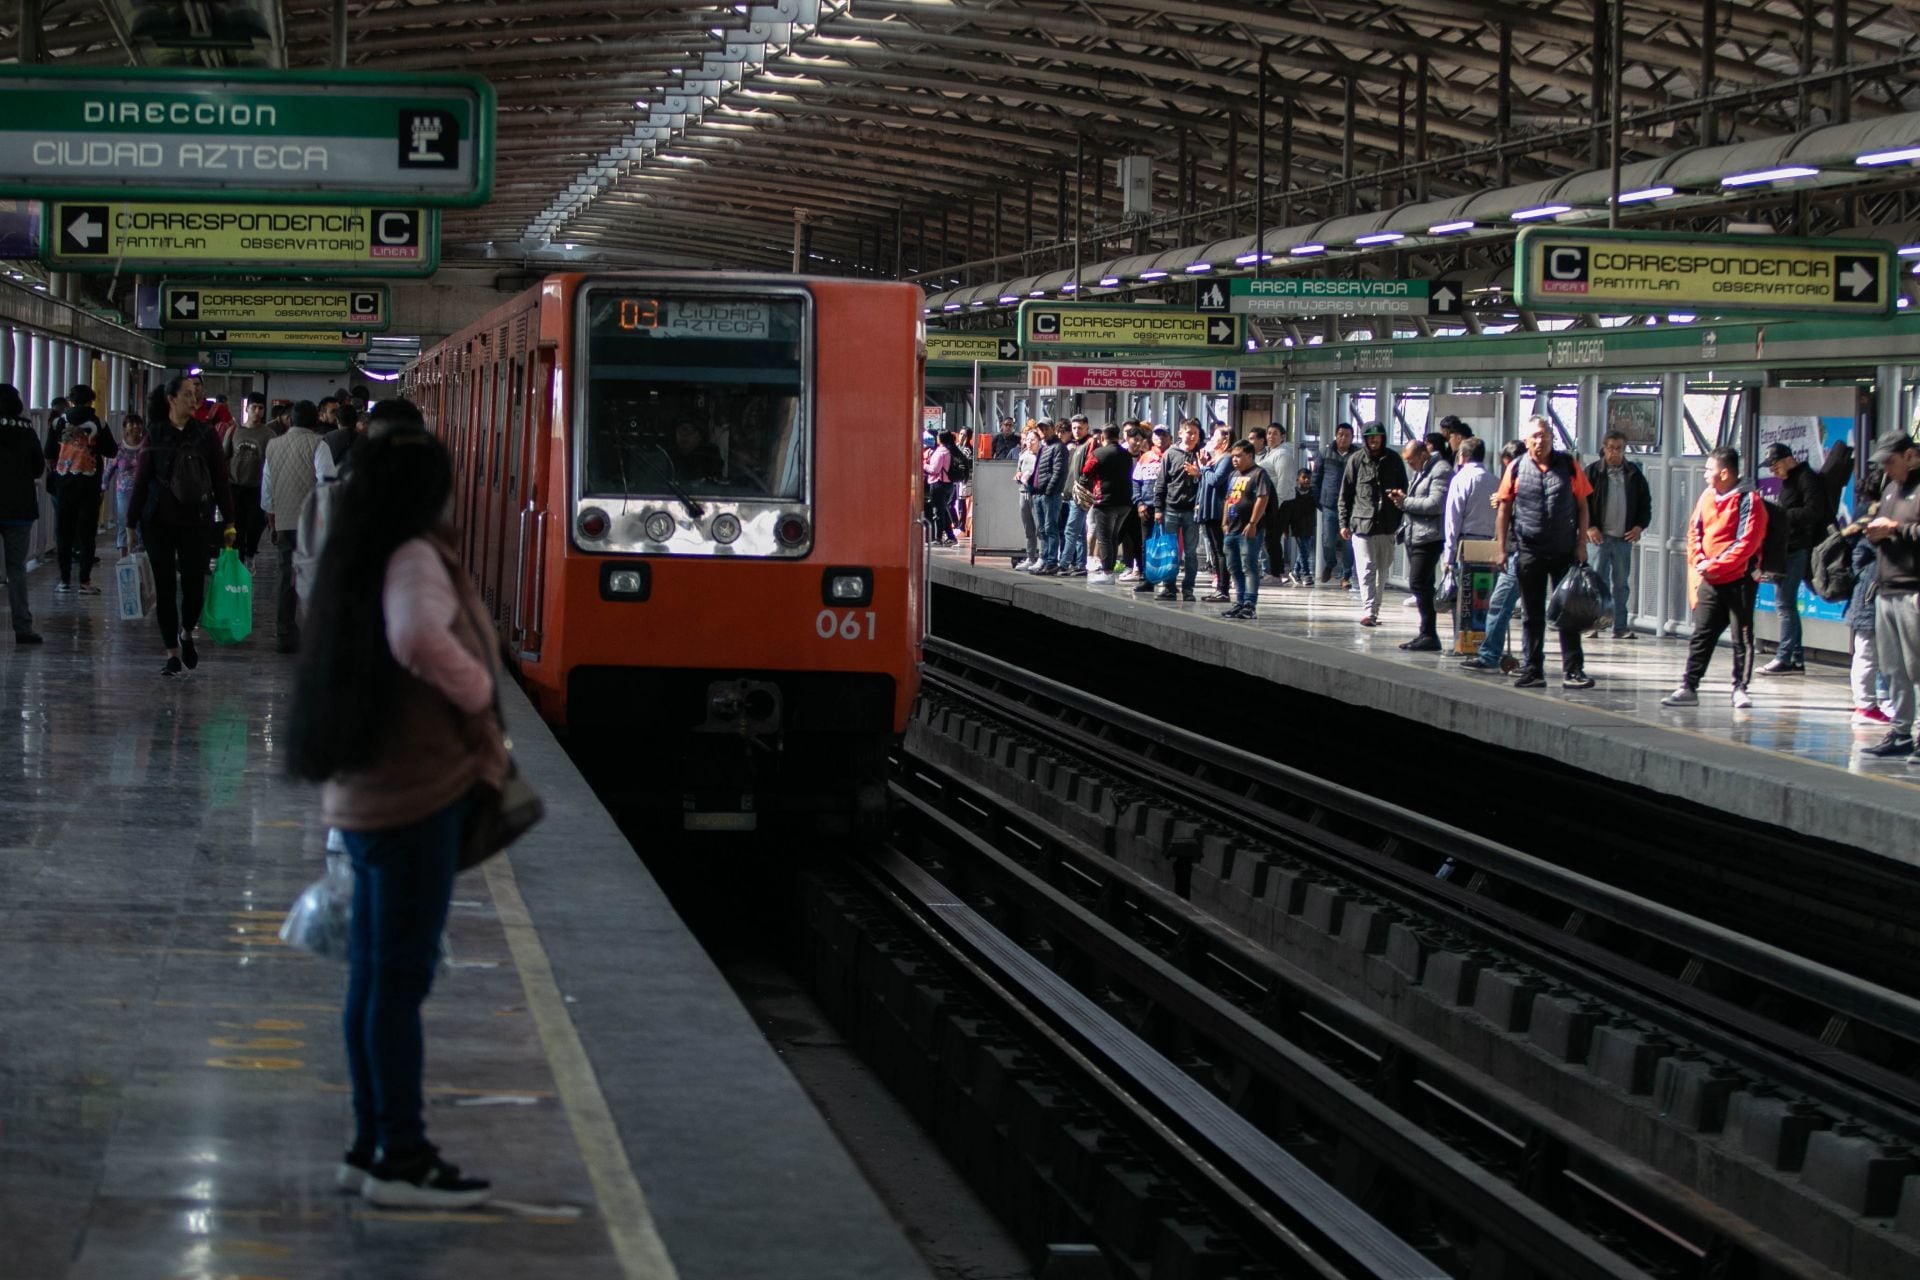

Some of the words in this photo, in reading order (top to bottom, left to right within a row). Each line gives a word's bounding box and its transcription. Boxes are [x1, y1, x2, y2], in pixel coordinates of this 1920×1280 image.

[84, 101, 276, 127] DIRECCION
[32, 140, 164, 168] CIUDAD
[178, 143, 328, 171] AZTECA
[116, 212, 364, 233] CORRESPONDENCIA
[378, 212, 410, 245] C
[116, 236, 206, 249] PANTITLAN
[240, 237, 364, 251] OBSERVATORIO
[373, 246, 406, 257] LINEA
[409, 247, 416, 257] 1
[1550, 247, 1582, 280] C
[1593, 252, 1830, 277] CORRESPONDENCIA
[1250, 281, 1297, 294] AREA
[1302, 281, 1408, 295] RESERVADA
[1544, 282, 1578, 292] LINEA
[1580, 282, 1585, 292] 1
[1593, 277, 1680, 291] PANTITLAN
[1712, 281, 1830, 296] OBSERVATORIO
[202, 295, 347, 306] CORRESPONDENCIA
[355, 294, 374, 313] C
[1248, 300, 1285, 310] PARA
[1288, 300, 1354, 310] MUJERES
[1357, 301, 1367, 311] Y
[1370, 299, 1409, 311] NIÑOS
[202, 308, 255, 316] PANTITLAN
[274, 309, 347, 318] OBSERVATORIO
[619, 300, 659, 330] 03
[1037, 314, 1056, 333] C
[1063, 316, 1205, 330] CORRESPONDENCIA
[1063, 330, 1116, 339] PANTITLAN
[1133, 332, 1205, 341] OBSERVATORIO
[1557, 341, 1572, 364] SAN
[1573, 339, 1604, 363] LAZARO
[1083, 377, 1138, 387] MUJERES
[1142, 379, 1149, 388] Y
[1087, 368, 1117, 377] AREA
[1122, 369, 1182, 379] EXCLUSIVA
[1462, 572, 1473, 618] SPECTRA
[816, 609, 877, 640] 061
